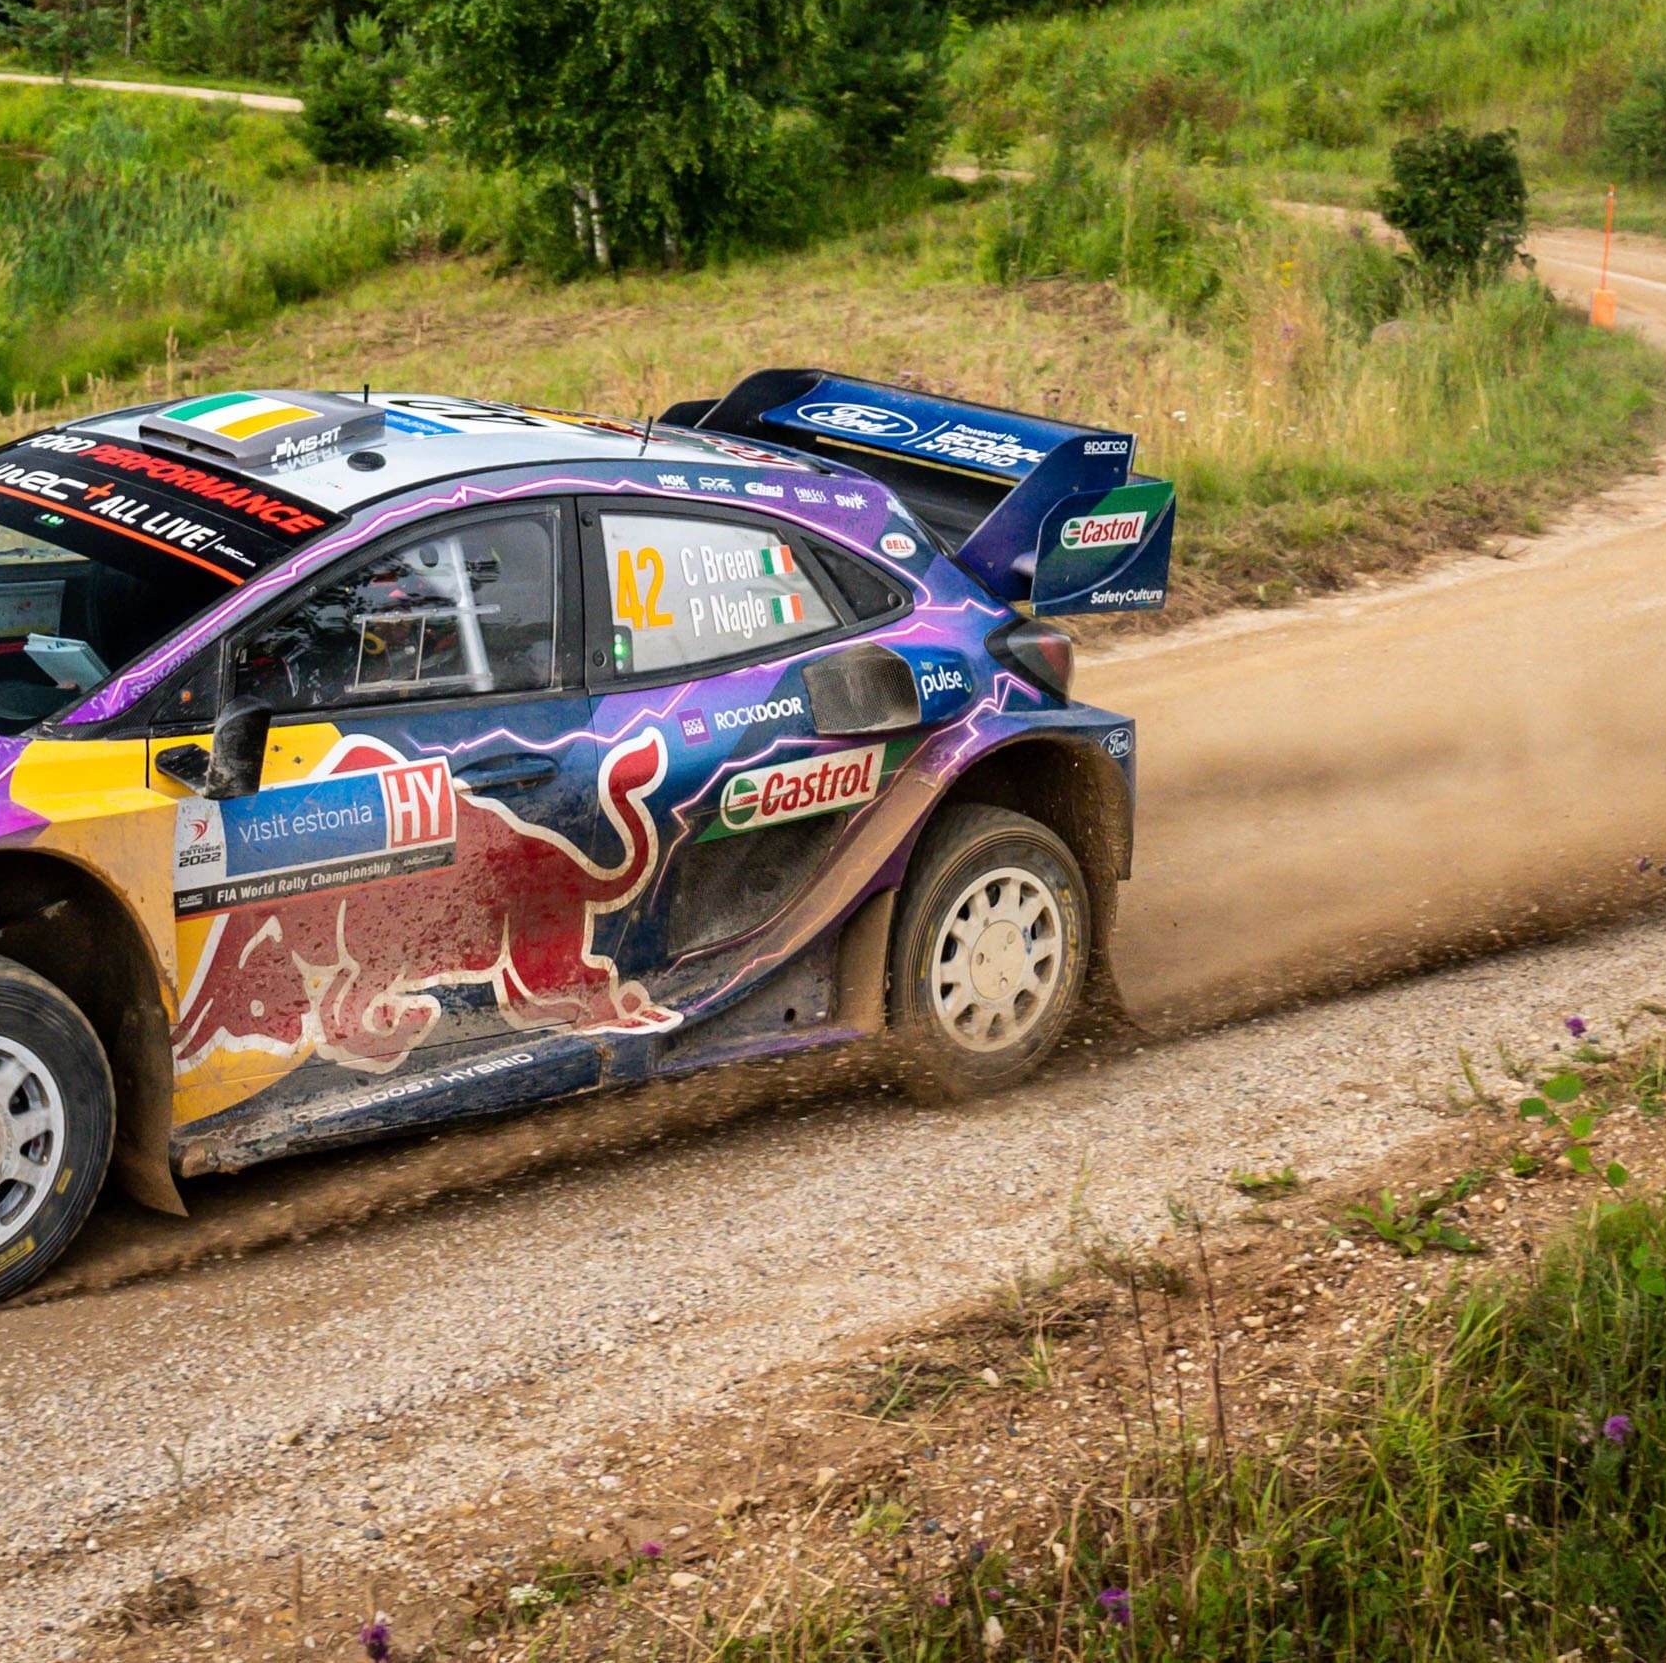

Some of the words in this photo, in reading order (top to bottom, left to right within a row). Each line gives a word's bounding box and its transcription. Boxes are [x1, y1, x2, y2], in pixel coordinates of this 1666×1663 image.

[810, 405, 900, 434] Ford
[953, 424, 1007, 440] Powered
[1004, 434, 1021, 443] by
[285, 427, 342, 458] MS-RT
[915, 441, 1018, 467] HYBRID
[1084, 440, 1129, 454] sparco
[17, 434, 96, 453] FORD
[77, 444, 326, 534] PERFORMANCE
[90, 495, 150, 525] ALL
[142, 512, 218, 551] LIVE
[1083, 516, 1140, 544] Castrol
[885, 539, 911, 550] BELL
[680, 547, 699, 587] C
[700, 545, 759, 584] Breen
[617, 546, 675, 630] 42
[1090, 589, 1164, 606] SafetyCulture
[689, 597, 705, 637] P
[710, 590, 767, 639] Nagle
[920, 666, 964, 700] pulse
[714, 697, 805, 730] ROCKDOOR
[1108, 732, 1129, 755] Ford
[761, 752, 873, 816] Castrol
[386, 768, 443, 842] HY
[238, 816, 288, 844] visit
[292, 802, 373, 834] estonia
[178, 852, 222, 868] 2022
[179, 844, 221, 857] ESTONIA
[217, 889, 237, 903] FIA
[240, 883, 275, 899] World
[278, 876, 308, 896] Rally
[310, 862, 391, 887] Championship
[440, 1053, 534, 1083] HYBRID
